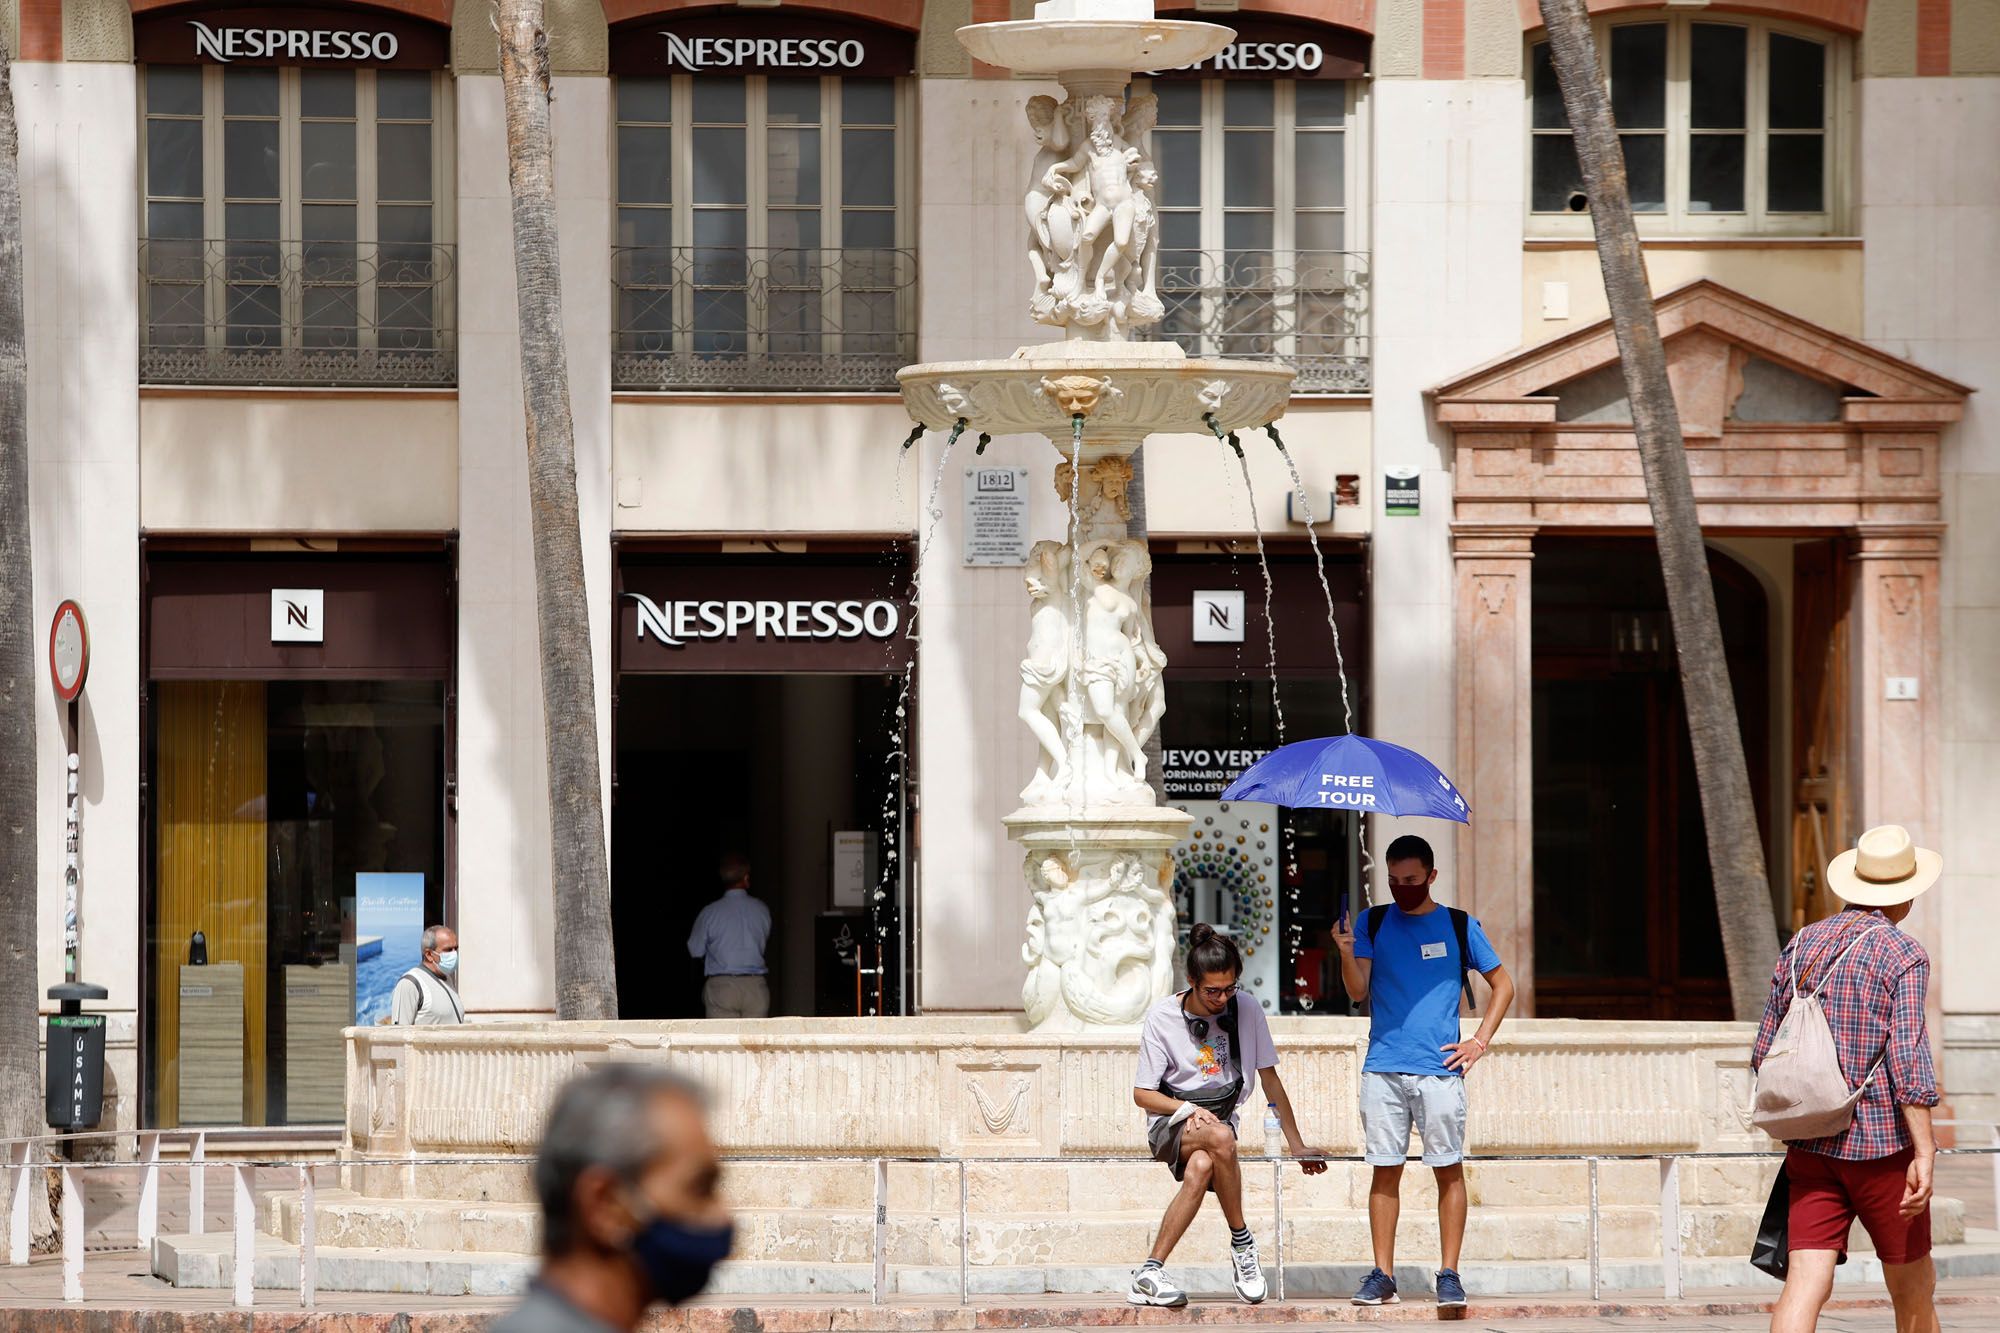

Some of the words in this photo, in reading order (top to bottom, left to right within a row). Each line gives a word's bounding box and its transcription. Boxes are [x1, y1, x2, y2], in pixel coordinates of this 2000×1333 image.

[187, 21, 398, 62] NESPRESSO
[658, 31, 865, 71] NESPRESSO
[983, 474, 1010, 485] 1812
[620, 592, 899, 646] NESPRESSO
[1213, 749, 1271, 767] VERT
[1163, 783, 1187, 793] CON
[1188, 783, 1204, 793] LO
[1321, 773, 1375, 788] FREE
[1317, 791, 1376, 807] TOUR
